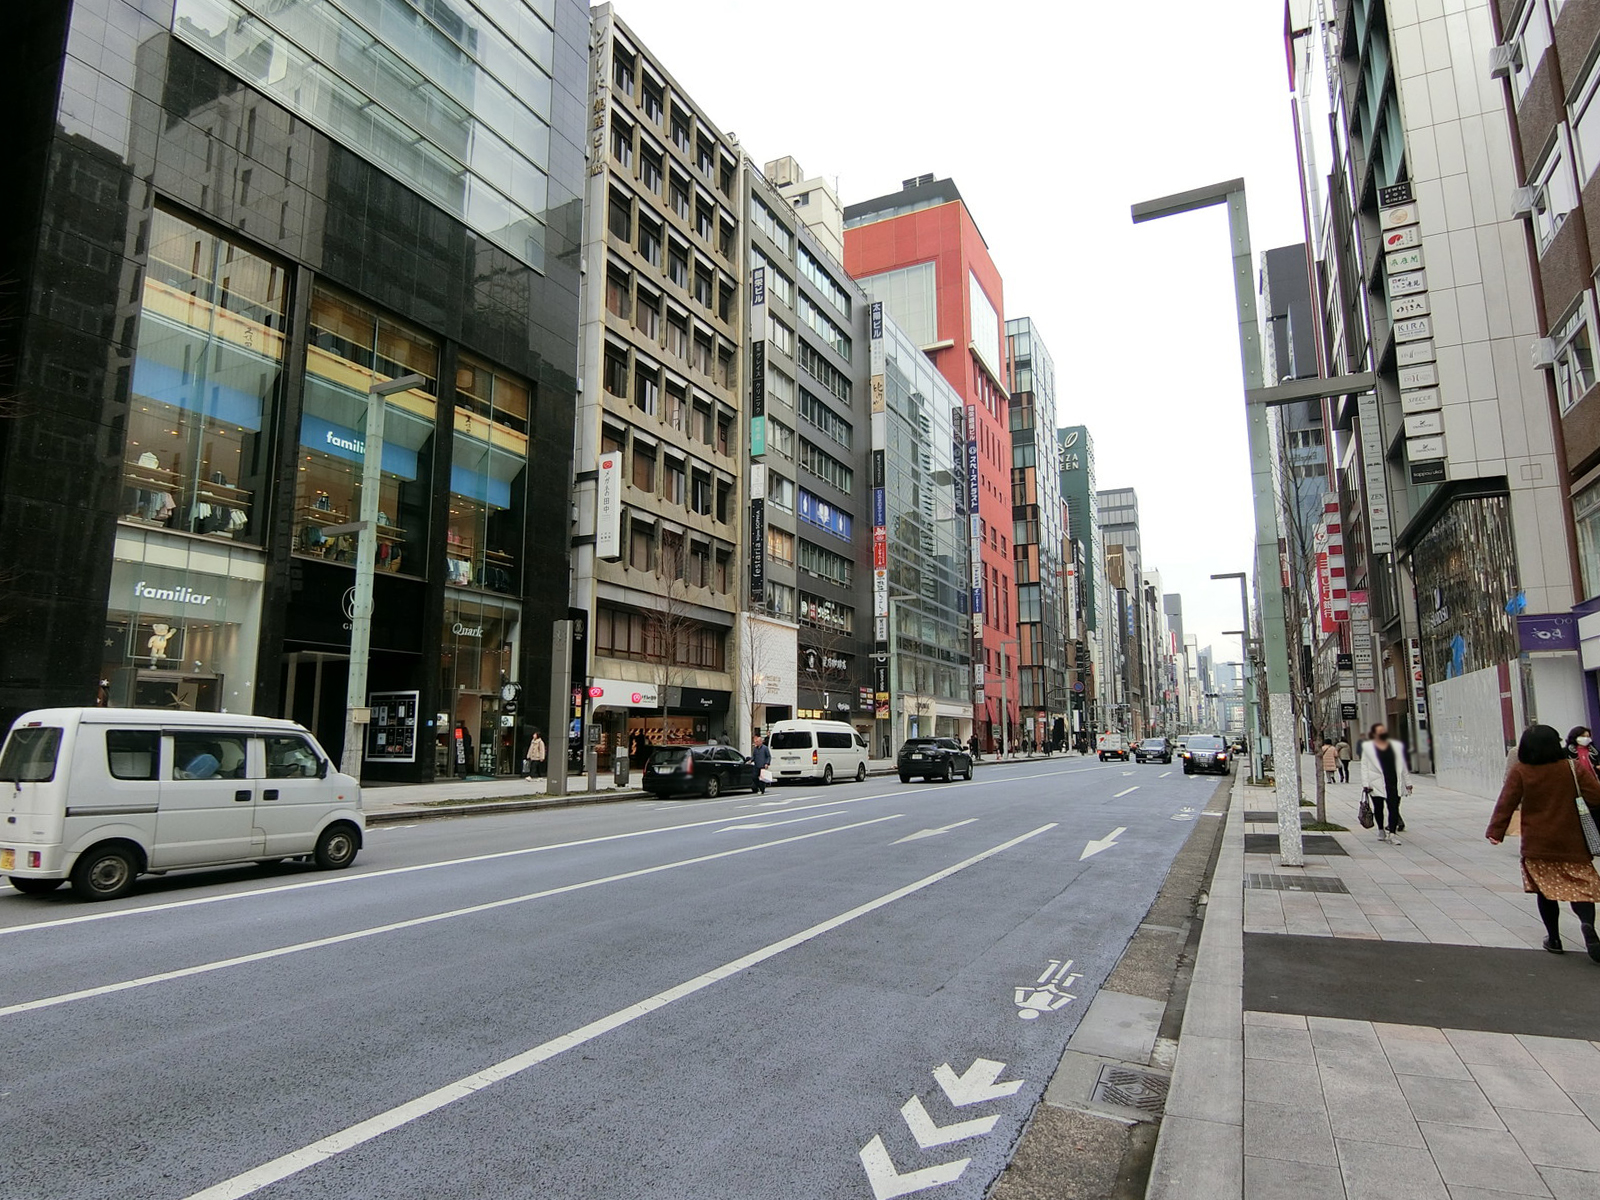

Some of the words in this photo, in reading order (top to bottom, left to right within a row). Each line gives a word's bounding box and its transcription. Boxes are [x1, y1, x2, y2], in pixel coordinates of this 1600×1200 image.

[1398, 322, 1425, 331] KIRA
[327, 431, 366, 454] famili
[753, 543, 761, 578] festaria
[135, 582, 211, 605] familiar
[453, 623, 484, 638] Quark
